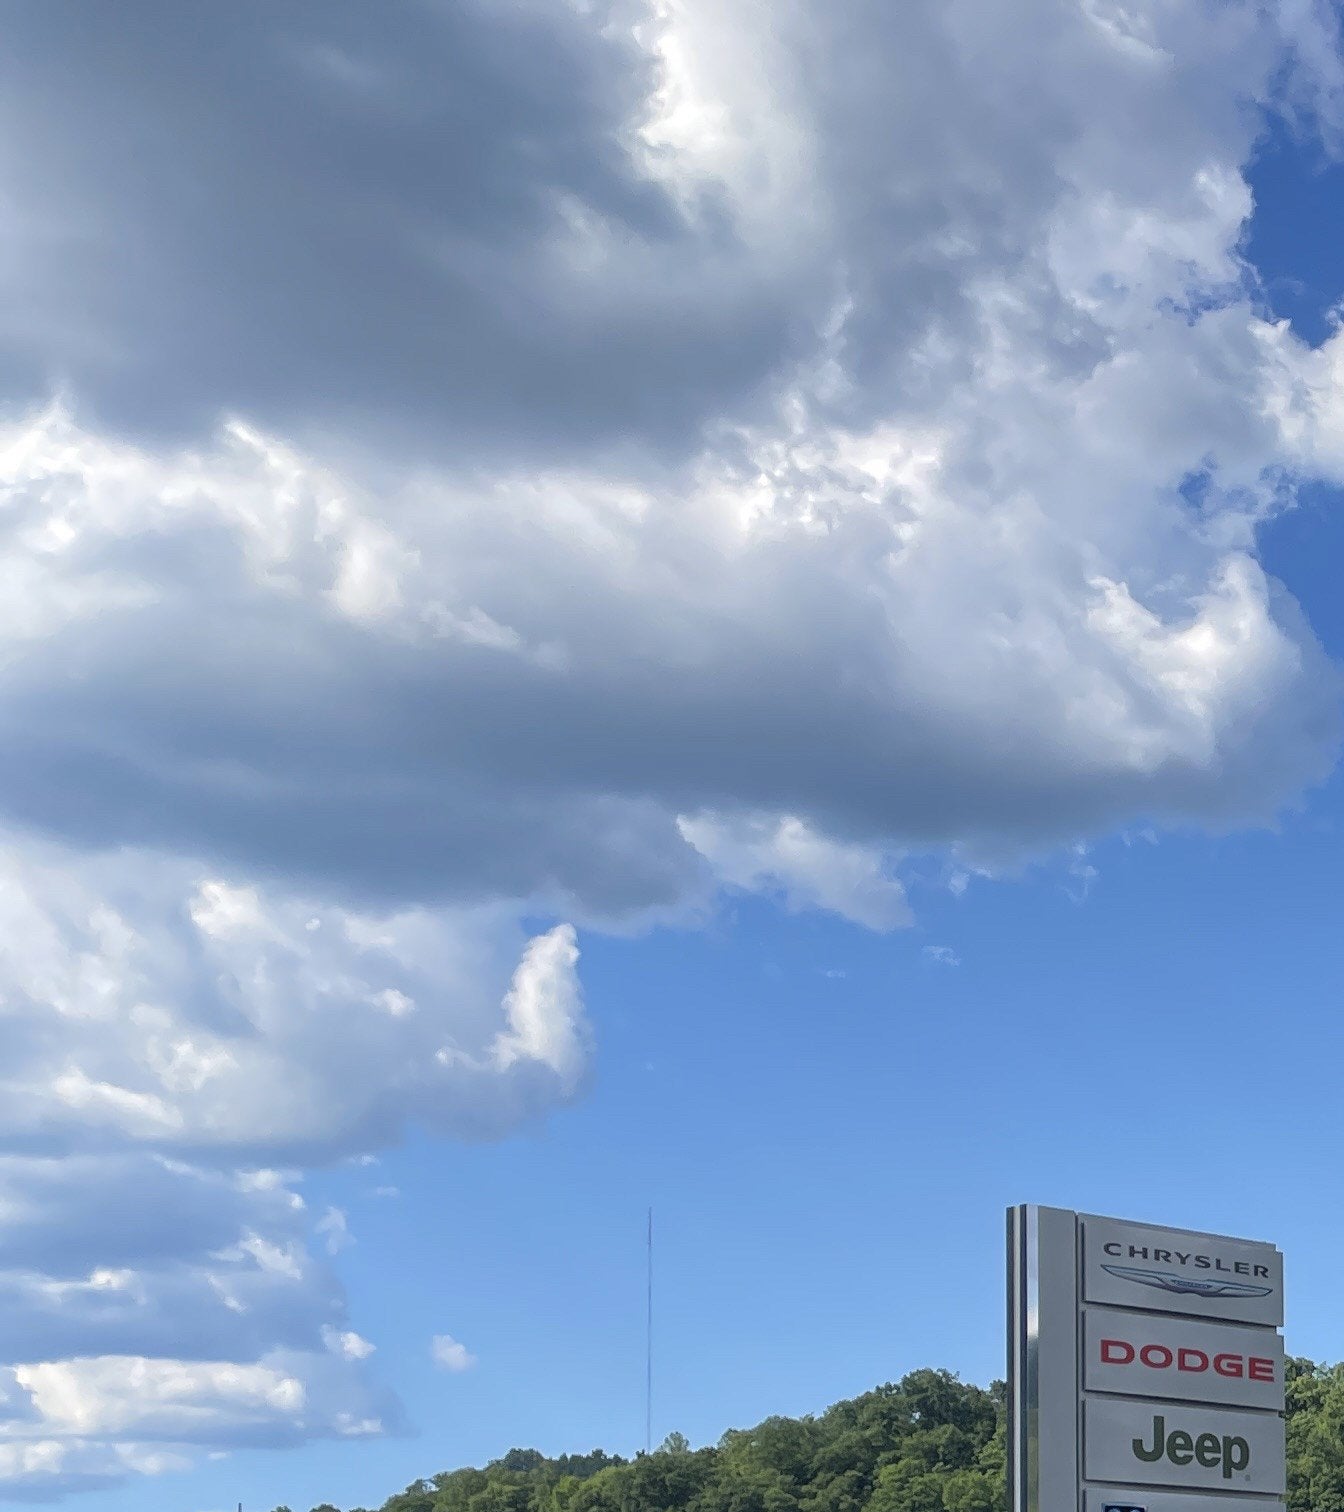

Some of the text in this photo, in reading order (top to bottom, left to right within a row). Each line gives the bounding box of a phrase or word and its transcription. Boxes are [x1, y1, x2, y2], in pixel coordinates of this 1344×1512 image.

[1103, 1242, 1269, 1279] CHRYSLER
[1100, 1339, 1275, 1382] DODGE
[1132, 1415, 1250, 1479] Jeep
